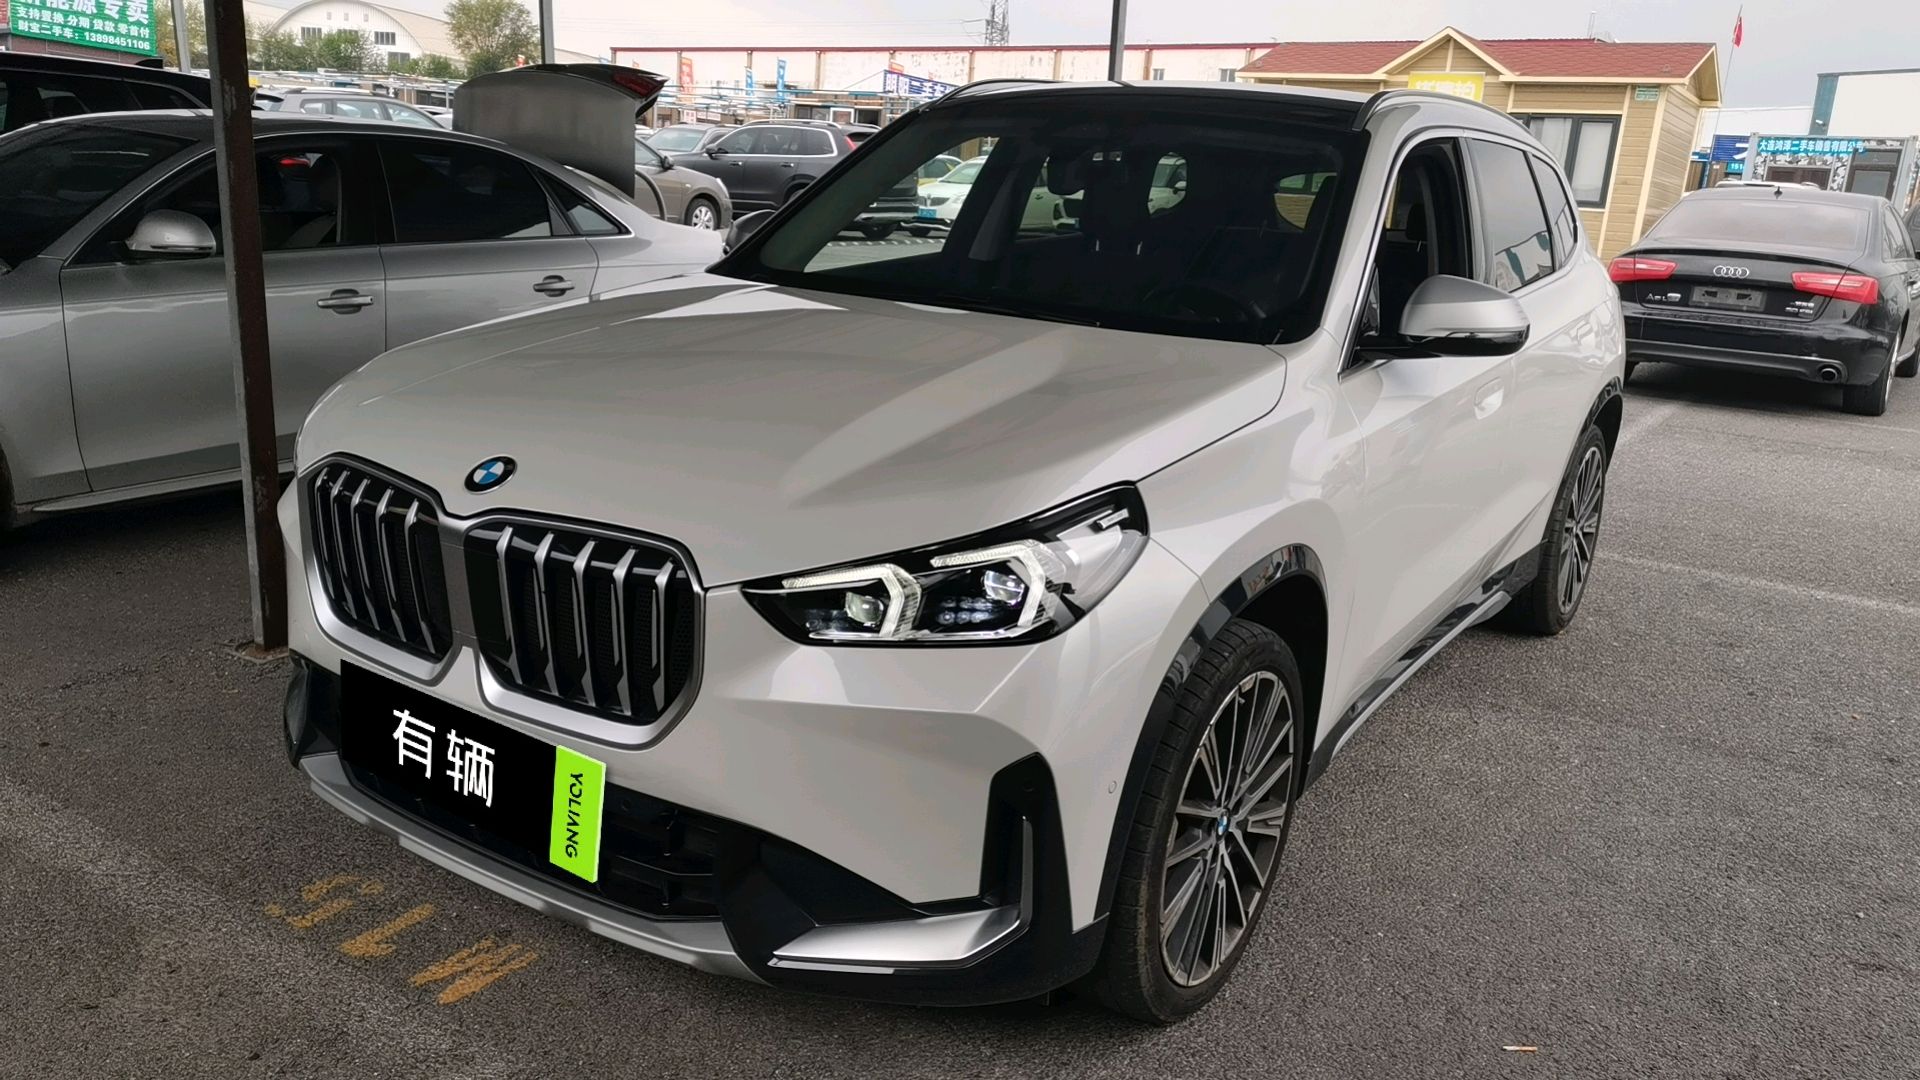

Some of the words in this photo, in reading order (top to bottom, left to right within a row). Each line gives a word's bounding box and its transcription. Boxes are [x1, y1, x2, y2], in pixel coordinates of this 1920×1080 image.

[20, 0, 150, 24] 源专卖
[67, 15, 90, 29] 分期
[92, 18, 115, 32] 贷款
[117, 23, 150, 38] 零首付
[83, 32, 151, 50] 13898451106
